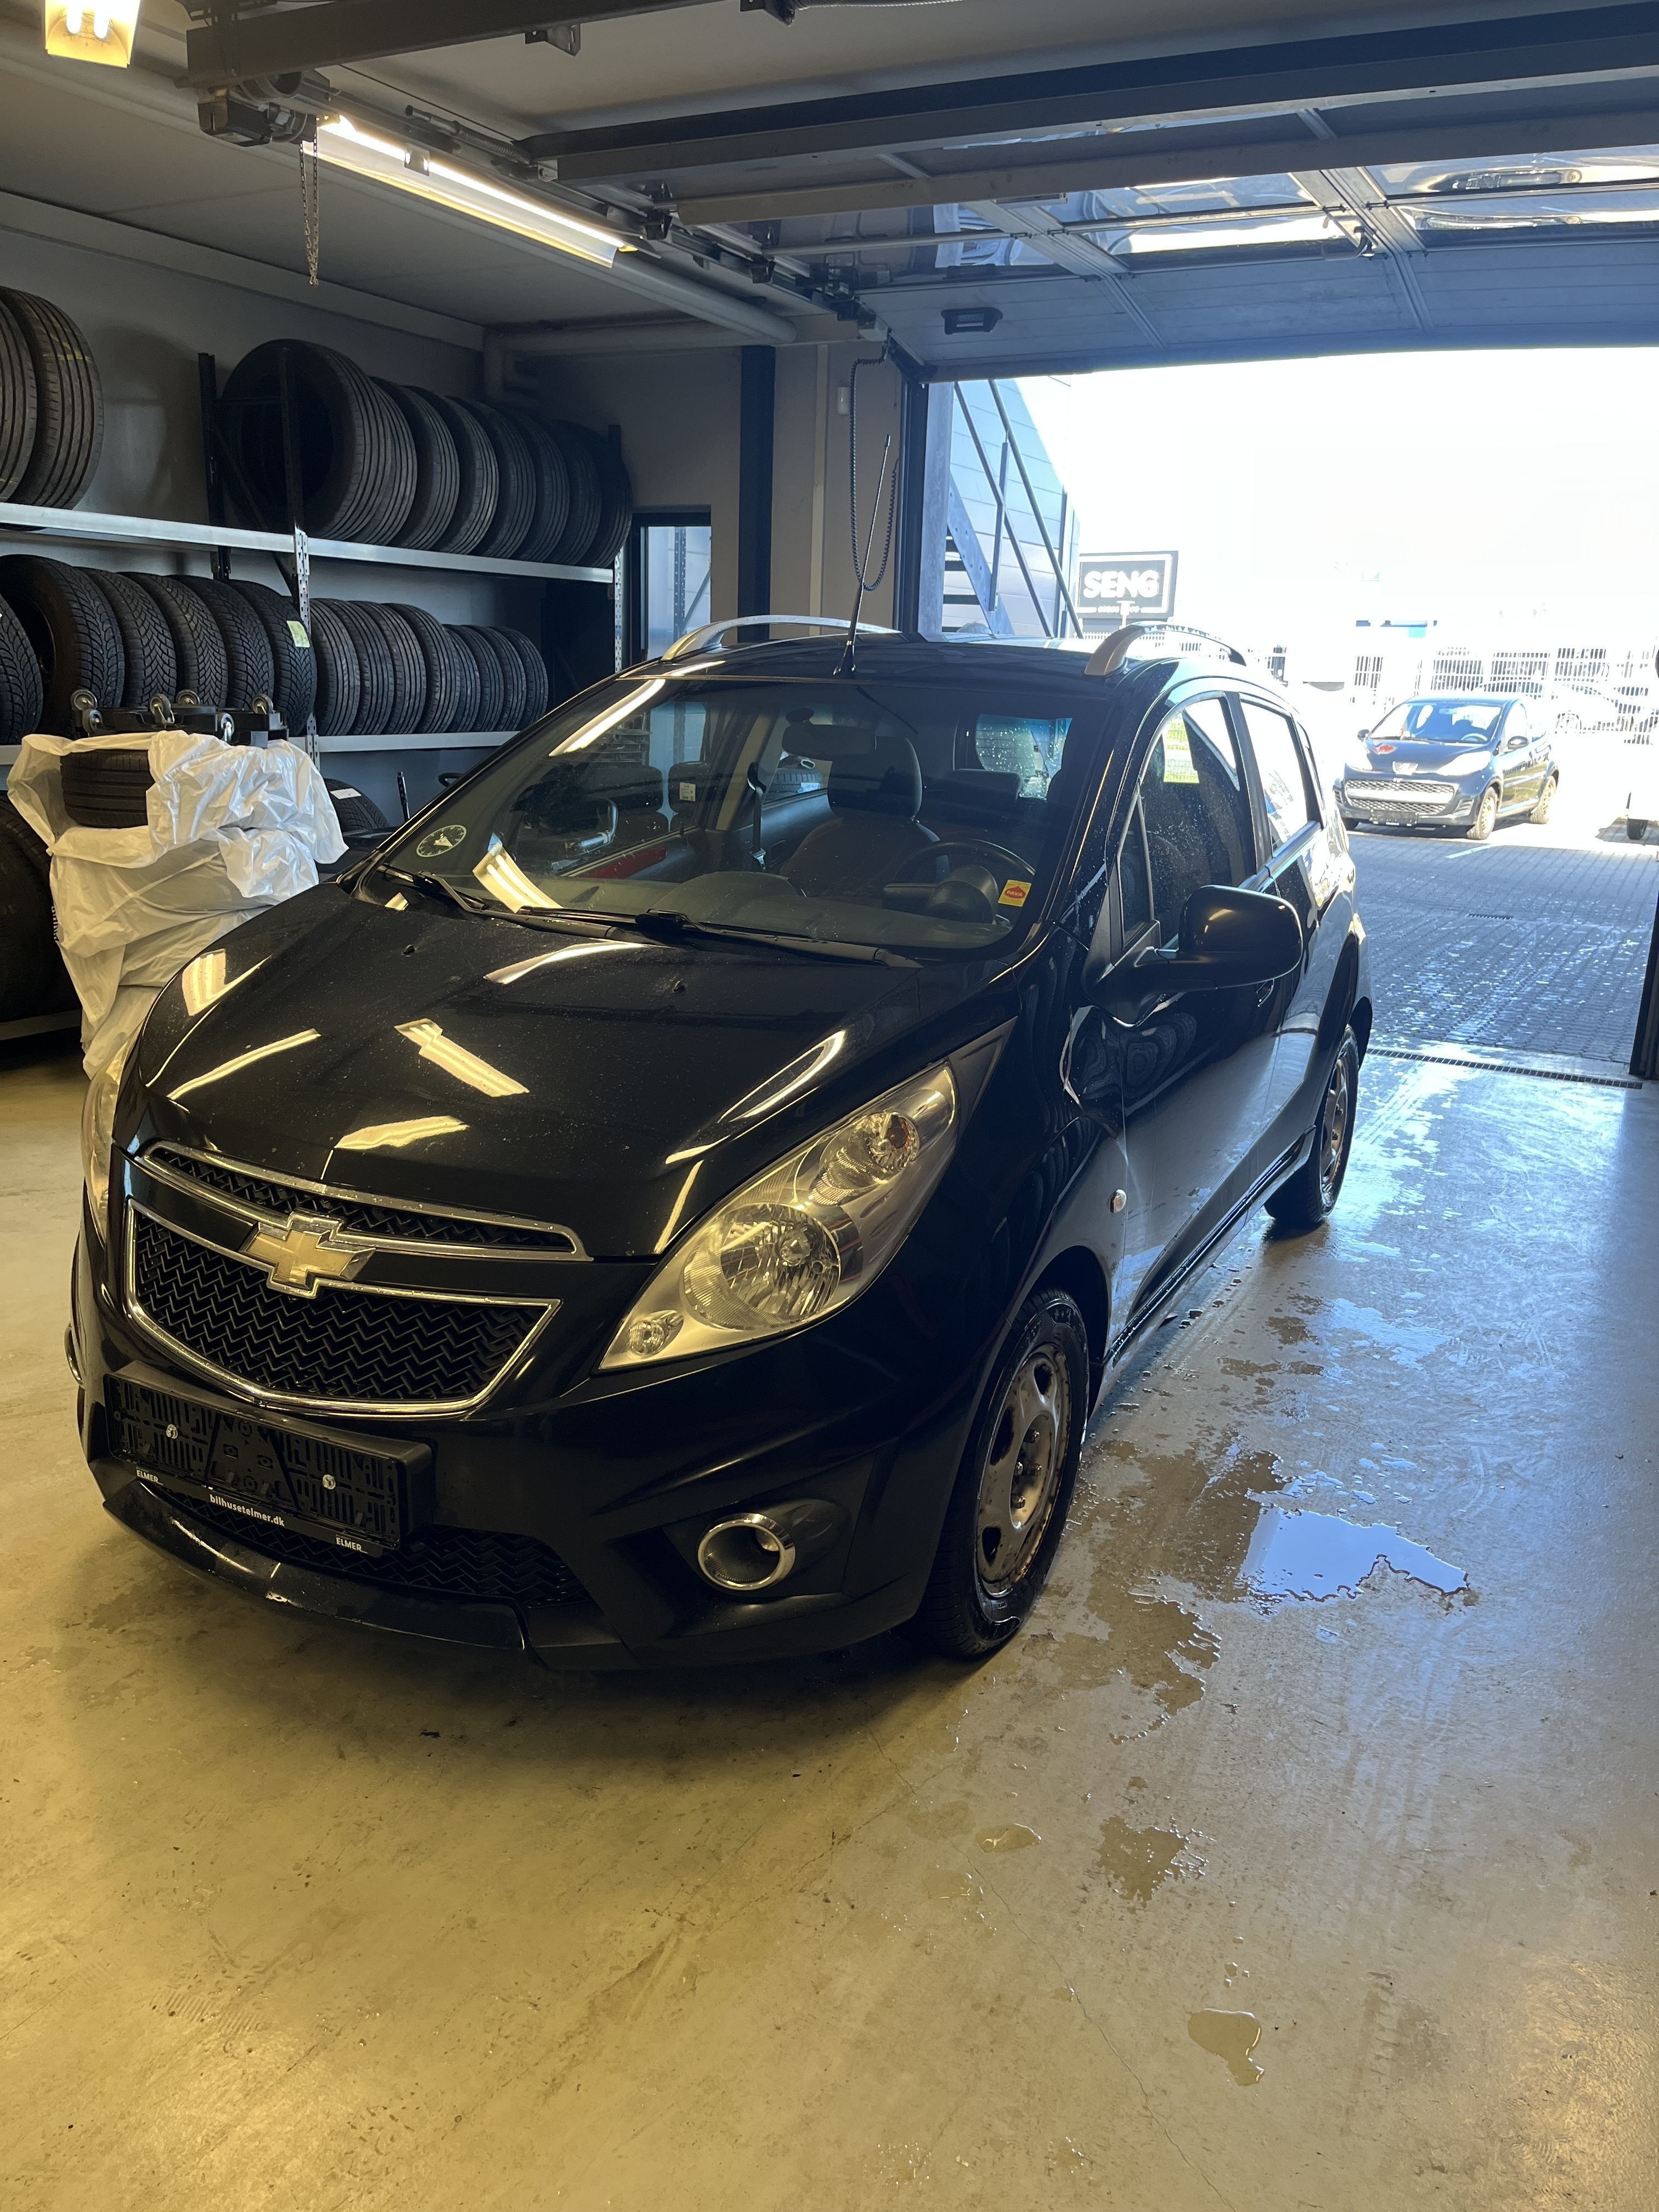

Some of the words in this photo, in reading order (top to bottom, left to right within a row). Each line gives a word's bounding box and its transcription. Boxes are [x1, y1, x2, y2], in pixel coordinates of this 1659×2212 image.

[1084, 570, 1159, 598] SENG
[137, 1470, 159, 1482] ELMER
[210, 1494, 285, 1526] bilhusetelmer.dk
[336, 1537, 363, 1552] ELMER
